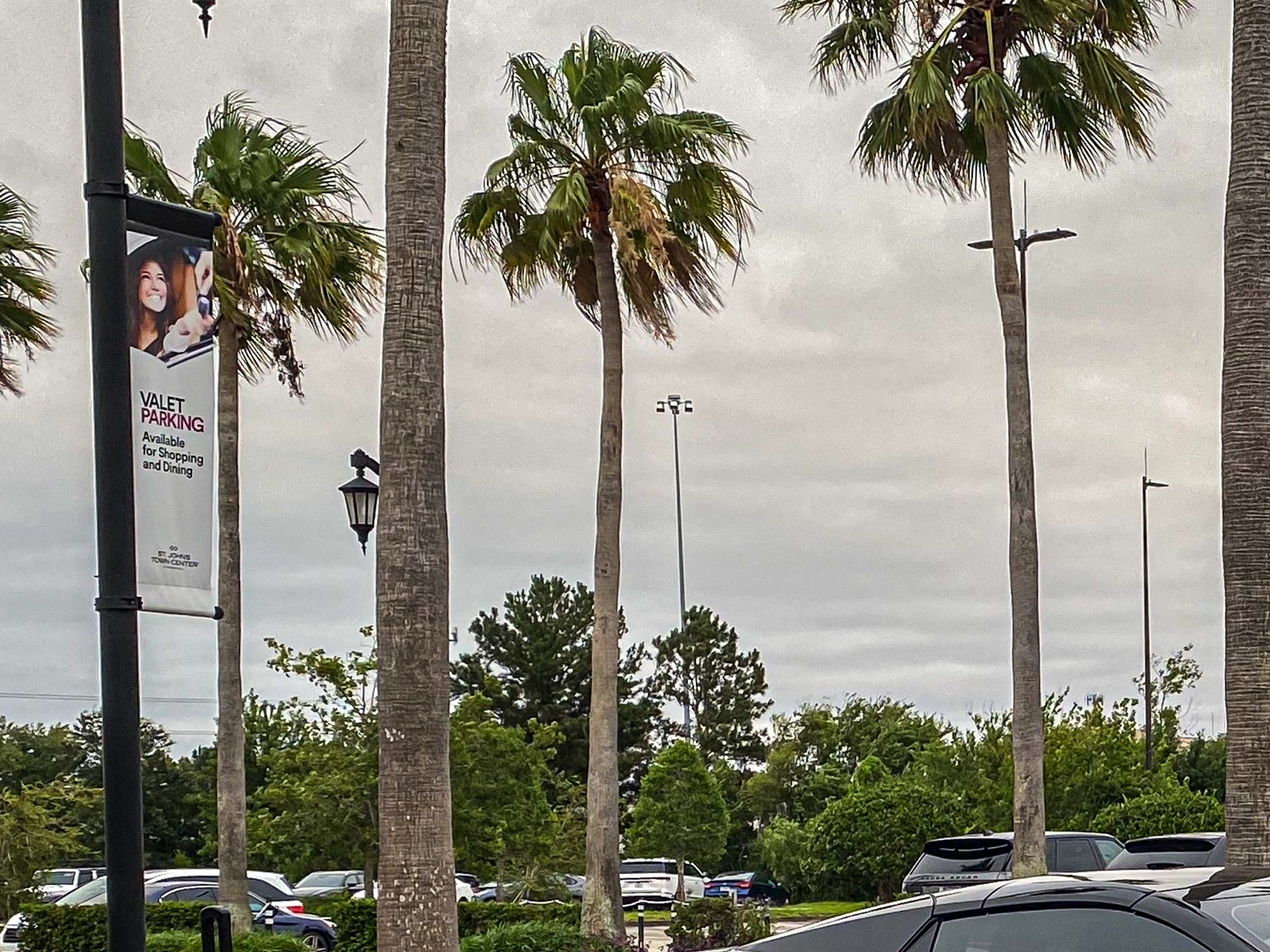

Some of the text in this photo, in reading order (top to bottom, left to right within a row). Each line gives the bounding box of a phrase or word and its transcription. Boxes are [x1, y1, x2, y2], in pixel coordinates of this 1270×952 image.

[140, 391, 185, 413] VALET
[141, 408, 204, 432] PARKING
[142, 431, 185, 448] Available
[142, 444, 204, 467] for Shopping
[143, 460, 193, 479] and Dining
[171, 559, 200, 568] CENTER
